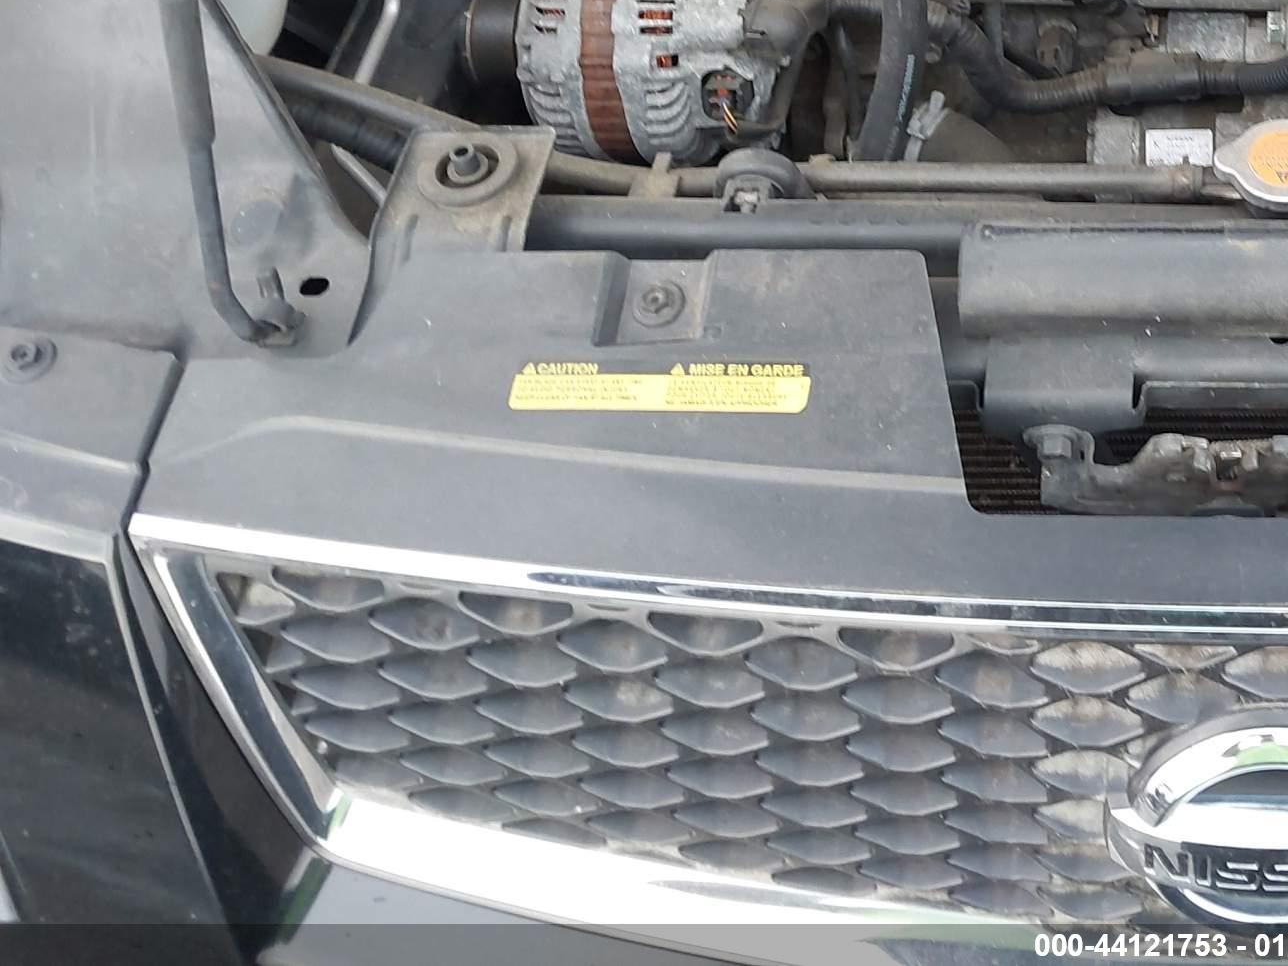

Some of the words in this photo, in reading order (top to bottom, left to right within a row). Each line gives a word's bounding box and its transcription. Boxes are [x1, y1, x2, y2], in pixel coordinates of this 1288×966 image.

[537, 362, 599, 375] CAUTION
[688, 363, 726, 376] MISE
[727, 364, 750, 376] EN
[750, 364, 804, 377] GARDE
